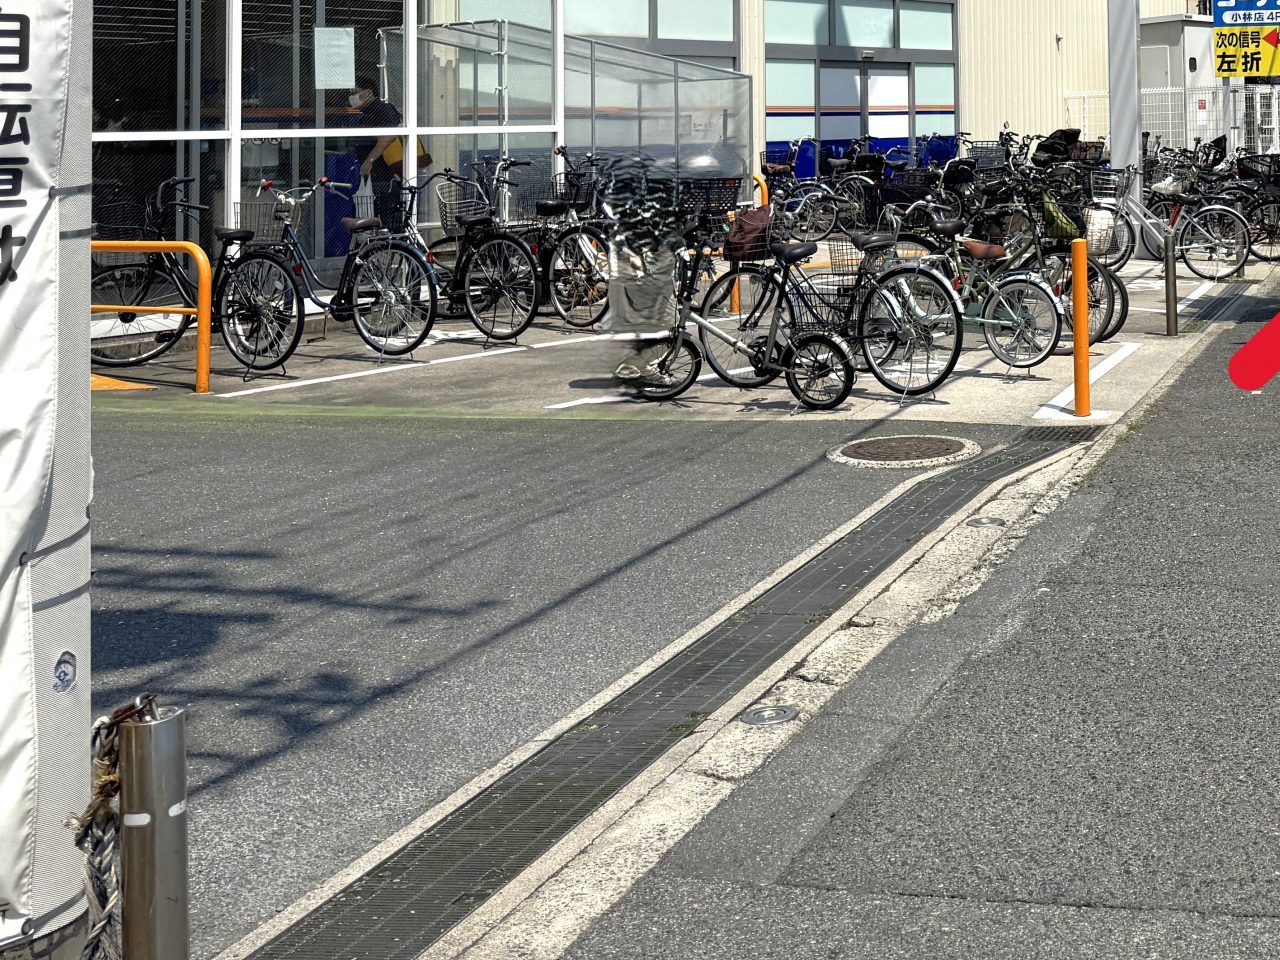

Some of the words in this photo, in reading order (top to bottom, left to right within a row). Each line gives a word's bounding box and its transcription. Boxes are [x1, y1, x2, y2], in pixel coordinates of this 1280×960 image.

[1231, 12, 1265, 22] 小林店
[1216, 31, 1261, 49] 次の信号
[1216, 51, 1262, 73] 左折
